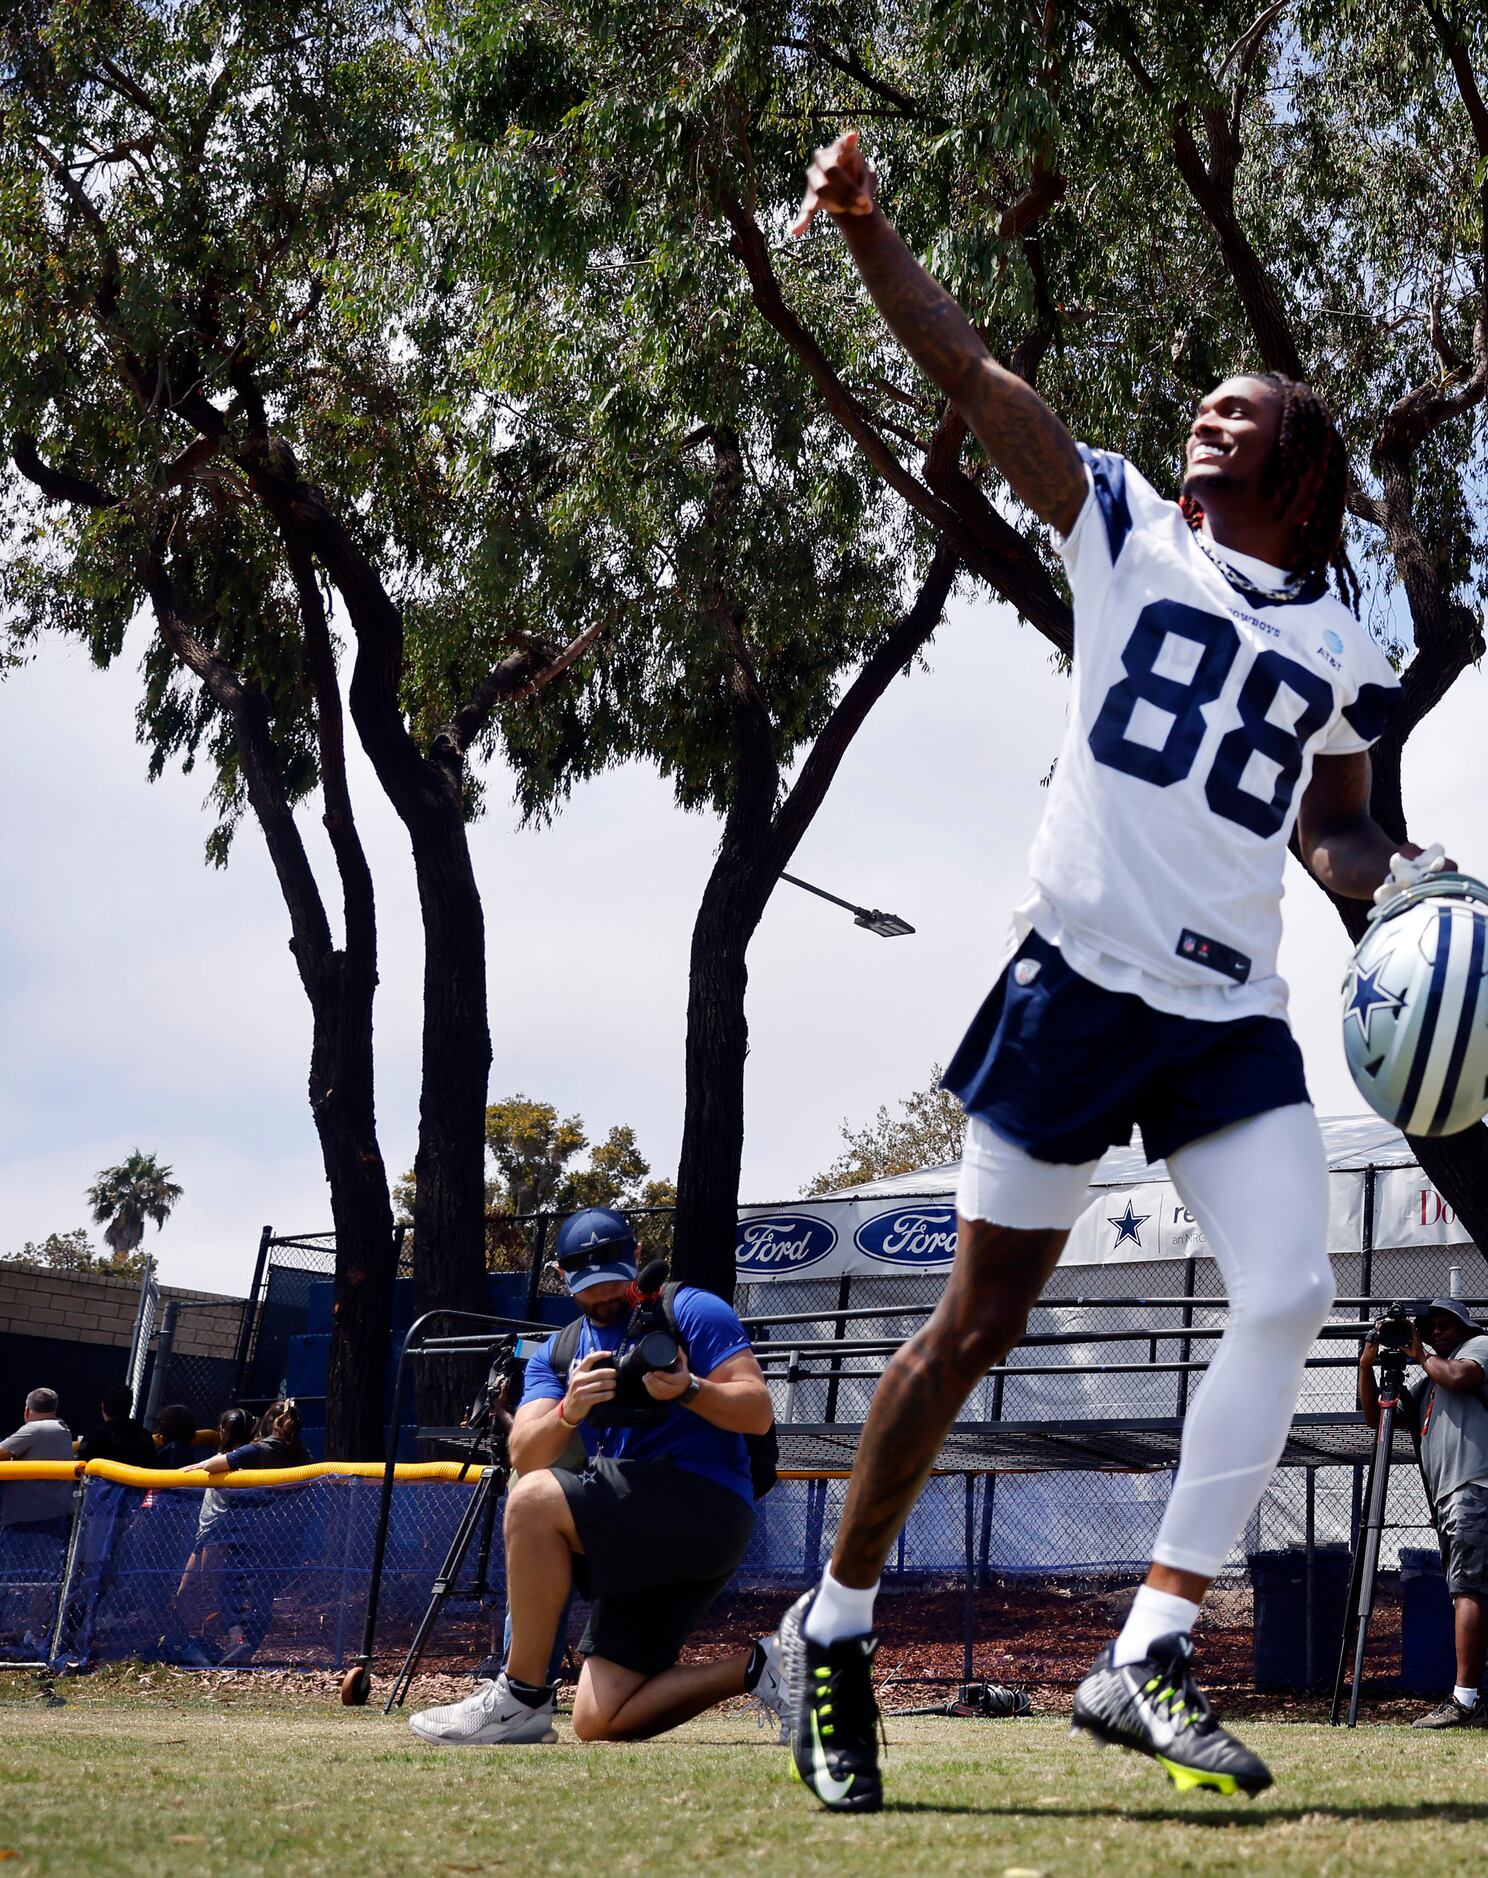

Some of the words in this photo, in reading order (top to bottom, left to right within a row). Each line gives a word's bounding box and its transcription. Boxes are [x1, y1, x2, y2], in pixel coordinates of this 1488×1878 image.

[1227, 607, 1281, 637] OWBOYS
[1088, 598, 1334, 839] 88
[735, 1224, 813, 1263] Ford
